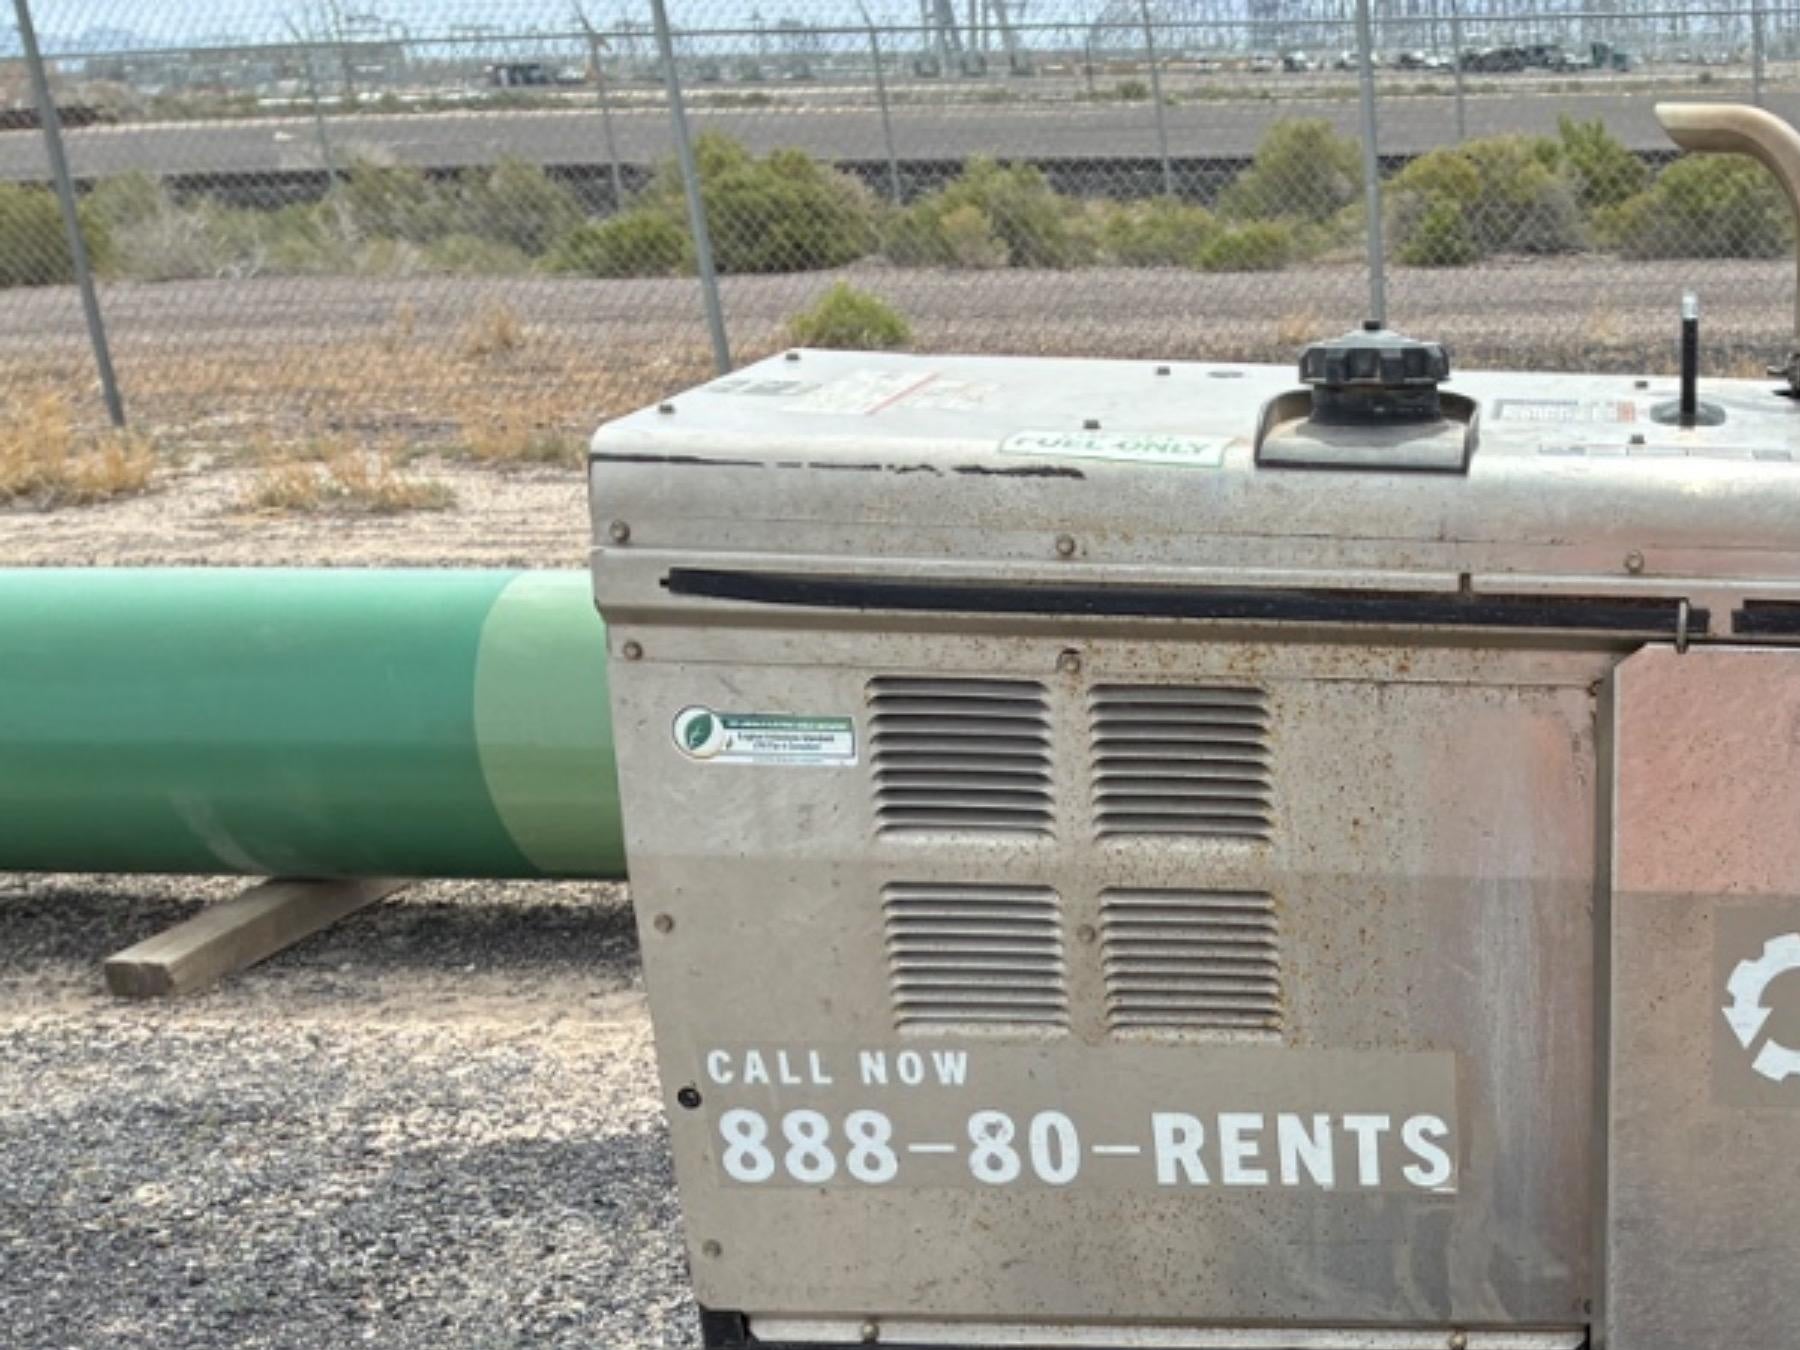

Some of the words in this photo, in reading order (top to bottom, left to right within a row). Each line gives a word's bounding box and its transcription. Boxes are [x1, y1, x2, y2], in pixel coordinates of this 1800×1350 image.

[1114, 435, 1211, 456] ONLY
[706, 1049, 833, 1085] CALL
[859, 1050, 969, 1086] NOW
[718, 1108, 1453, 1187] 888-80-RENTS
